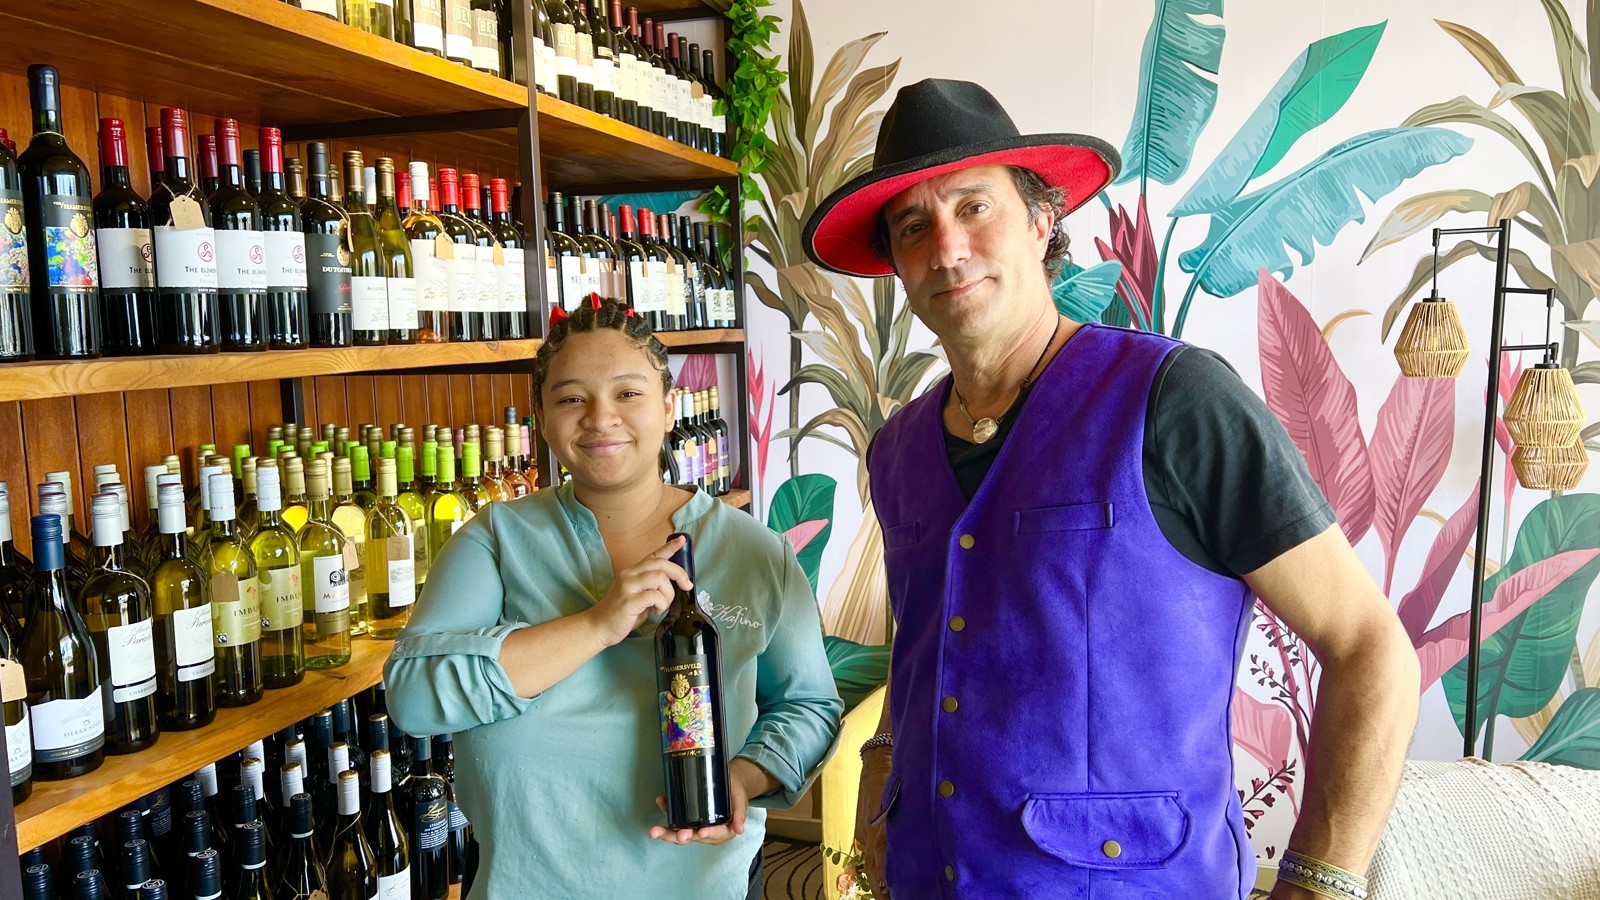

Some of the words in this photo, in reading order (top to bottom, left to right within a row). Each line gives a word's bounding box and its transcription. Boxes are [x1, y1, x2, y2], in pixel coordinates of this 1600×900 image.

[129, 266, 142, 274] THE
[712, 604, 762, 629] Kafino
[63, 727, 87, 738] SIERRA
